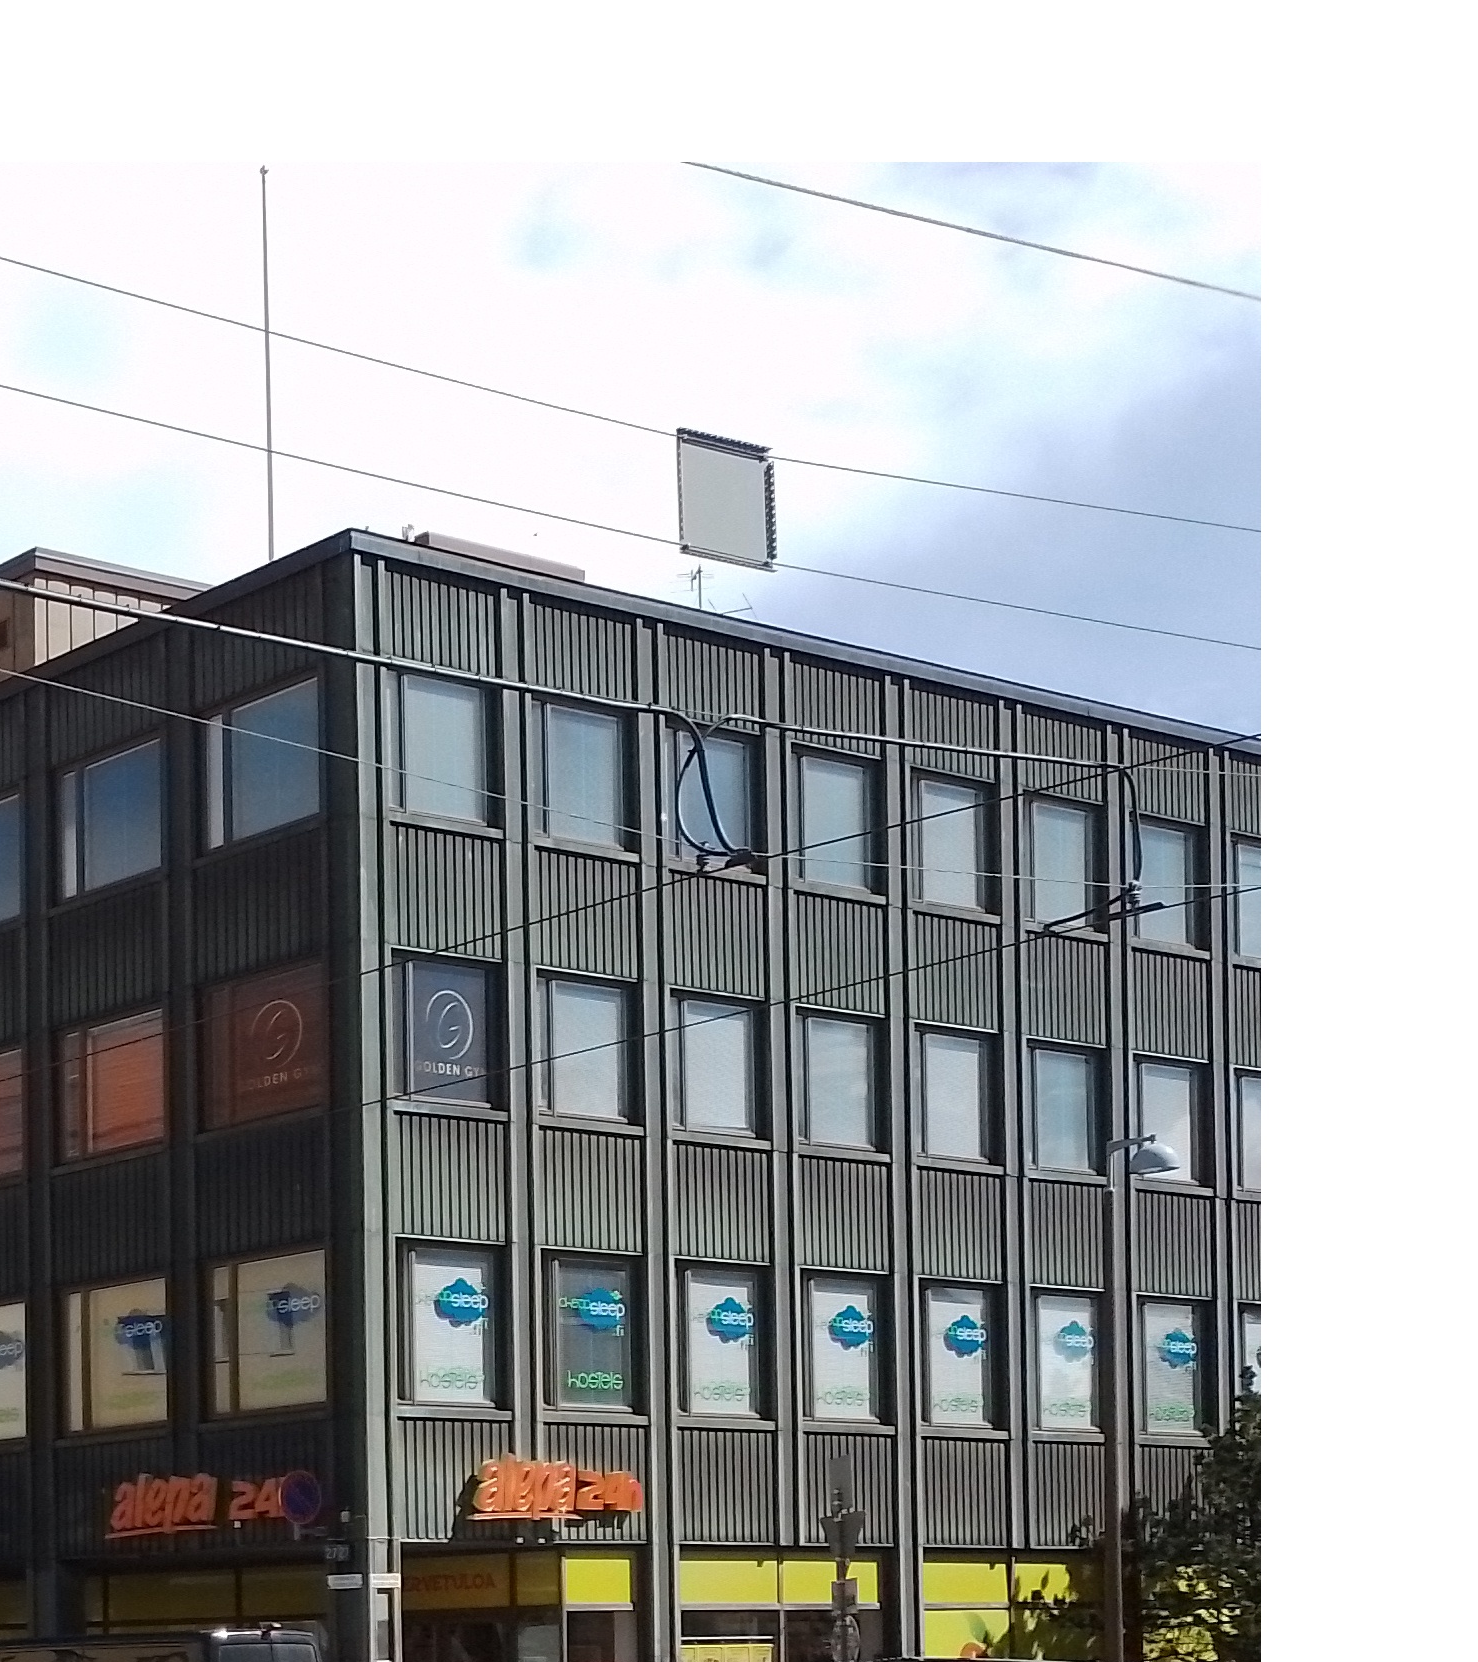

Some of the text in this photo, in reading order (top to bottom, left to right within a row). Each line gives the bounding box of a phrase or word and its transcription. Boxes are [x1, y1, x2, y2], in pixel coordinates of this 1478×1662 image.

[107, 1472, 289, 1537] alepa 24
[473, 1453, 576, 1520] alepa
